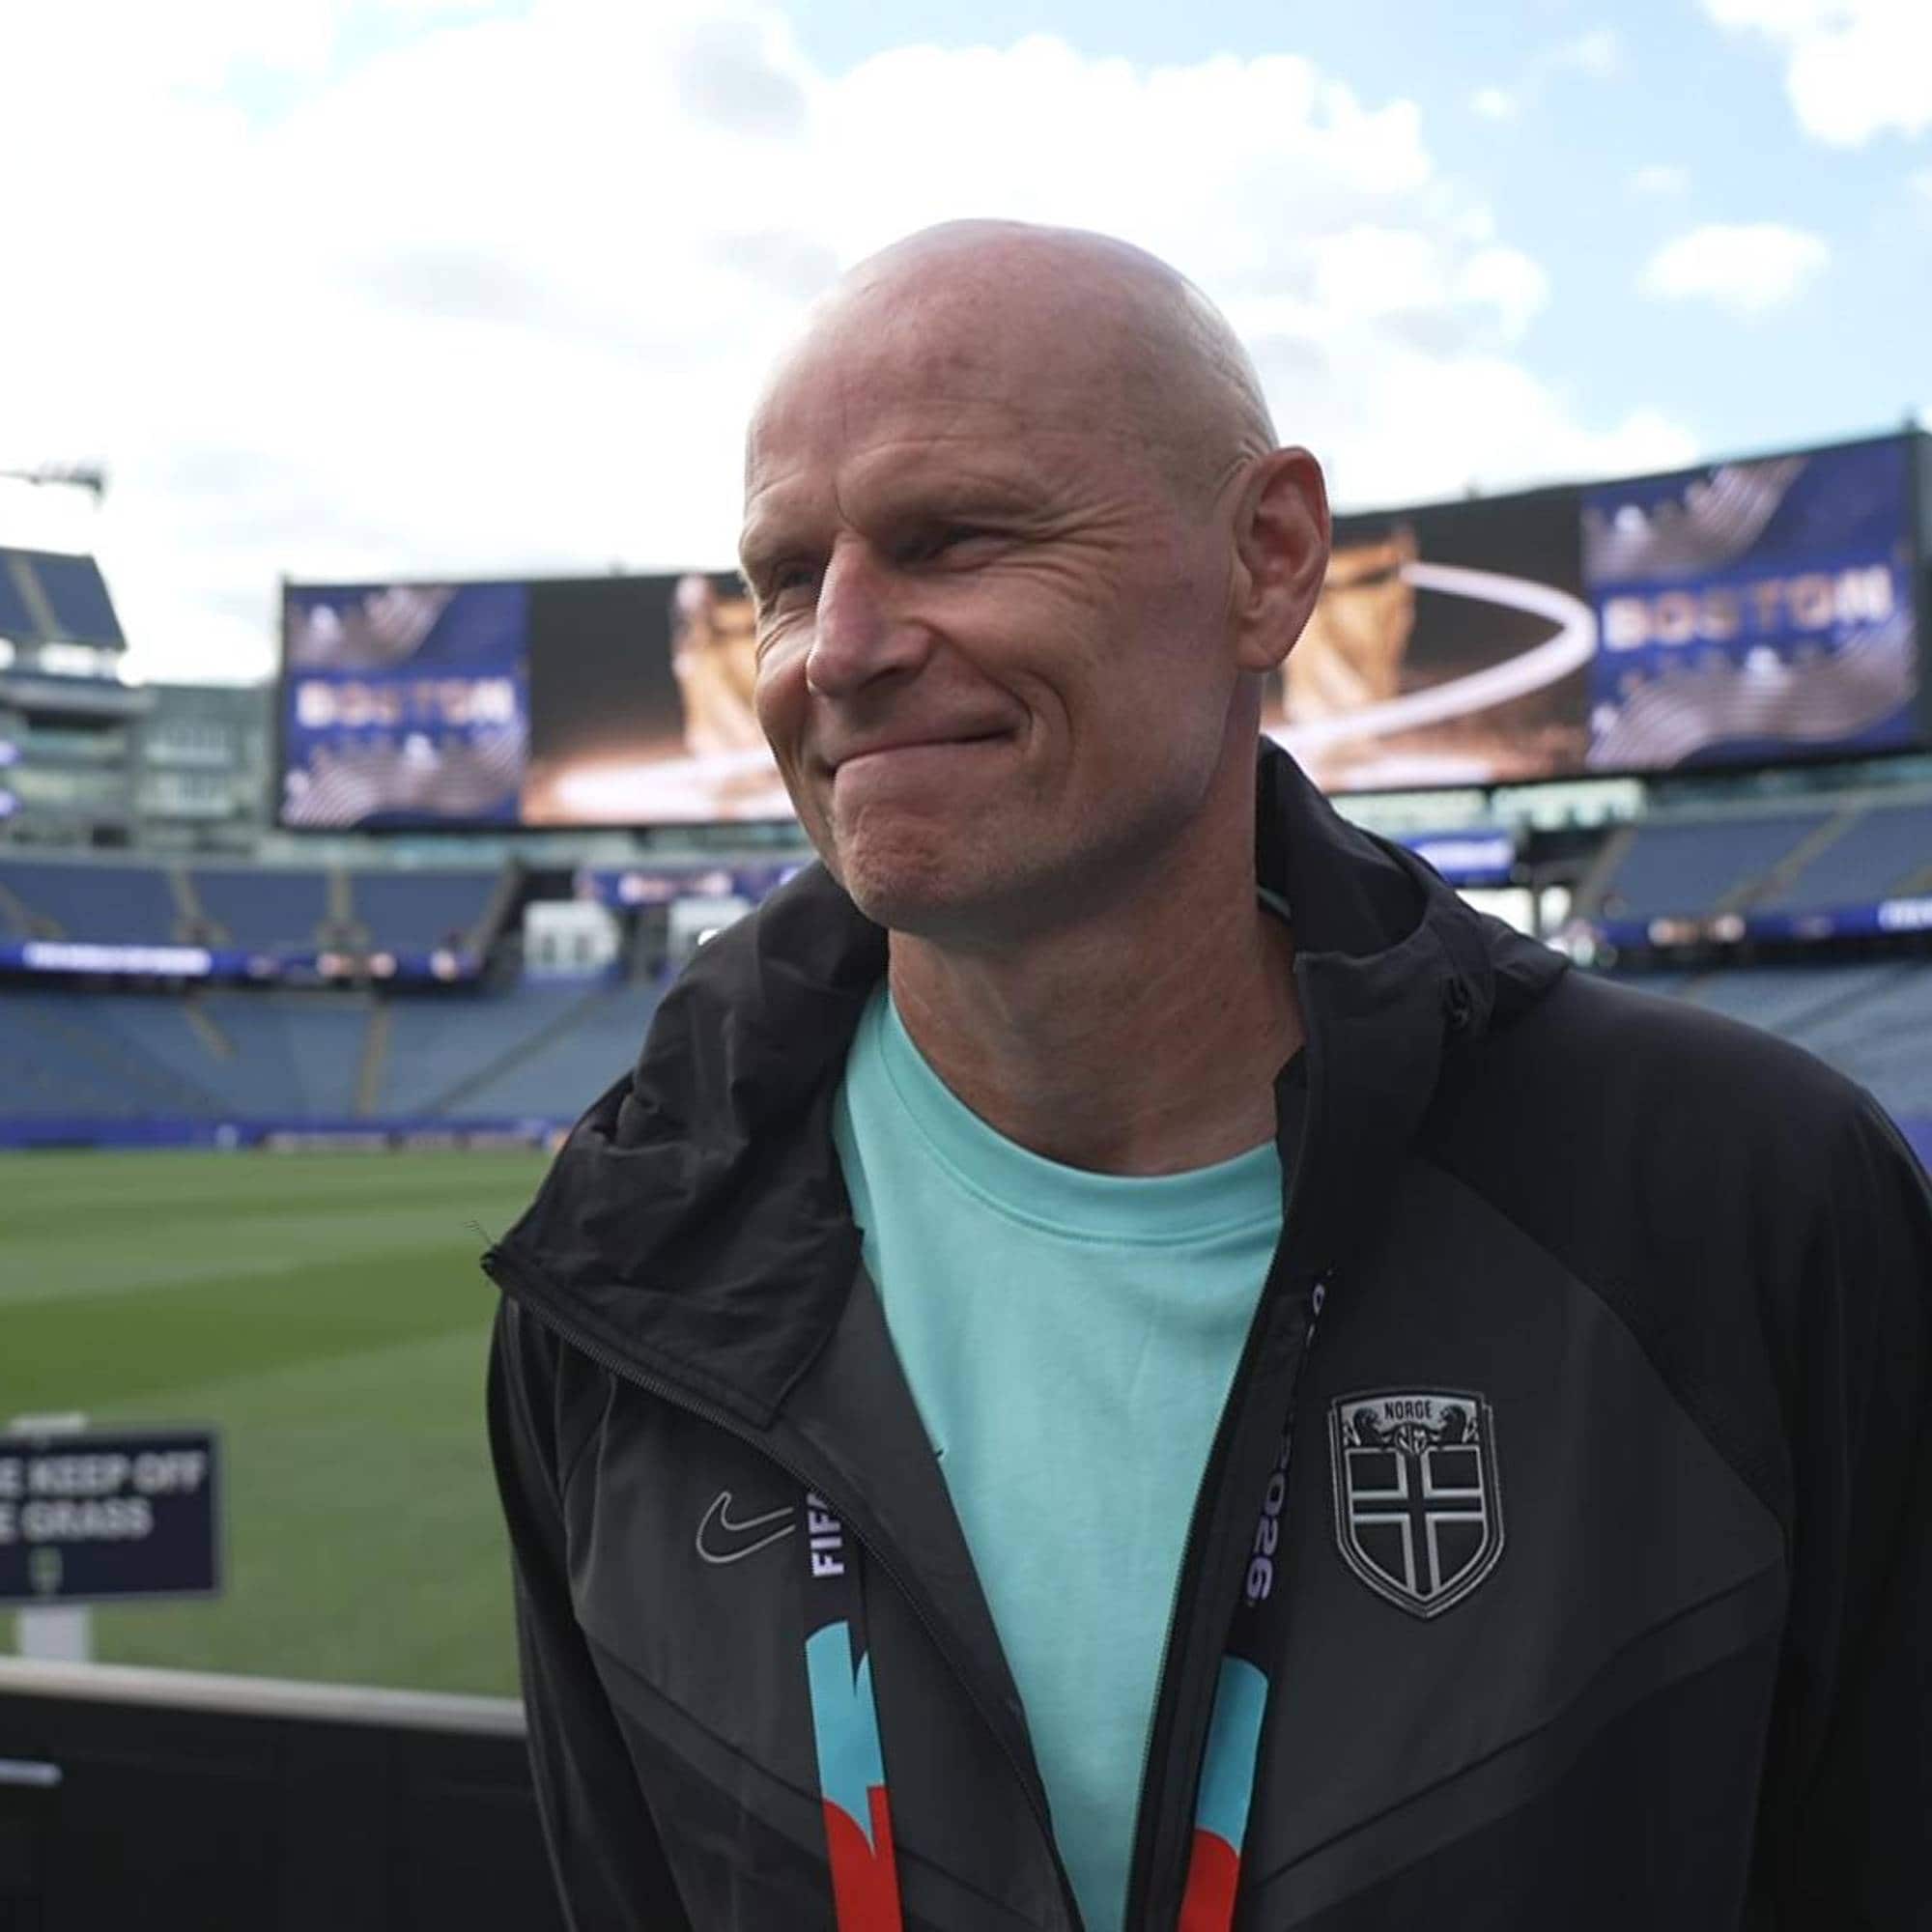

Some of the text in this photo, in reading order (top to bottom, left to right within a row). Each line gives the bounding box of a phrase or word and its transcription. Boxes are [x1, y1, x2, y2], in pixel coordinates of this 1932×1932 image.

[1603, 565, 1893, 652] BOSTON
[1383, 1400, 1433, 1420] NORGE
[28, 1454, 131, 1494] KEEP
[133, 1451, 205, 1492] OFF
[21, 1496, 153, 1541] GRASS
